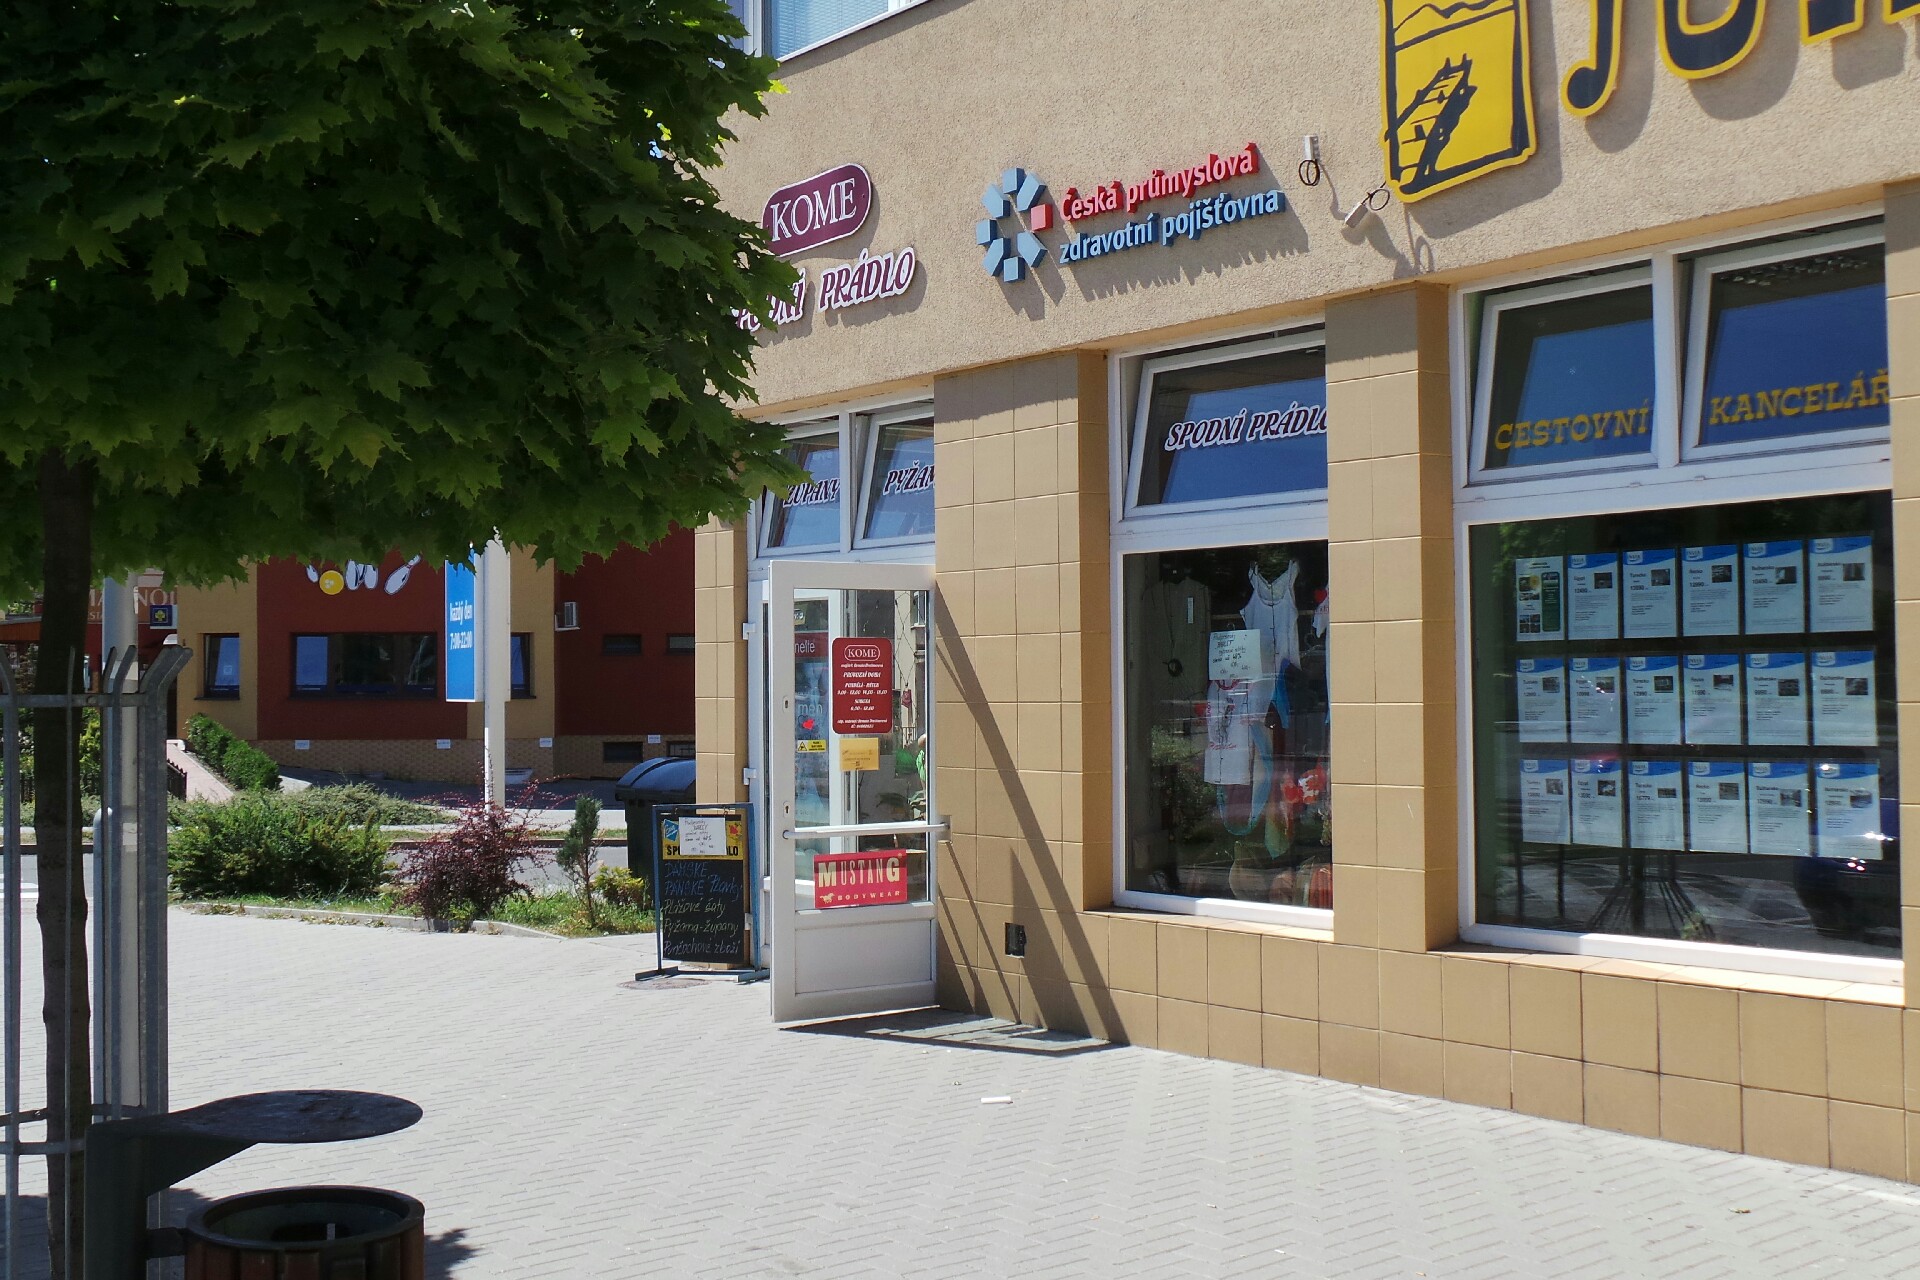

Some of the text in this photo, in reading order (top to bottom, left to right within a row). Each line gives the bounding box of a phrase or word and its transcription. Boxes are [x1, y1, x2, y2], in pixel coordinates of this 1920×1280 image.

[1060, 143, 1259, 222] Česká průmyslová
[769, 178, 857, 242] KOME
[1059, 190, 1285, 264] zdravotní pojišťovna
[818, 248, 915, 313] PRÁDLO
[1165, 408, 1247, 451] SPODNÍ
[1495, 369, 1890, 450] CESTOVNÍ KANCELÁŘ
[450, 600, 473, 626] každý den
[848, 648, 877, 658] KOME
[818, 856, 901, 888] MUSTANG
[837, 890, 900, 901] BODYWEAR
